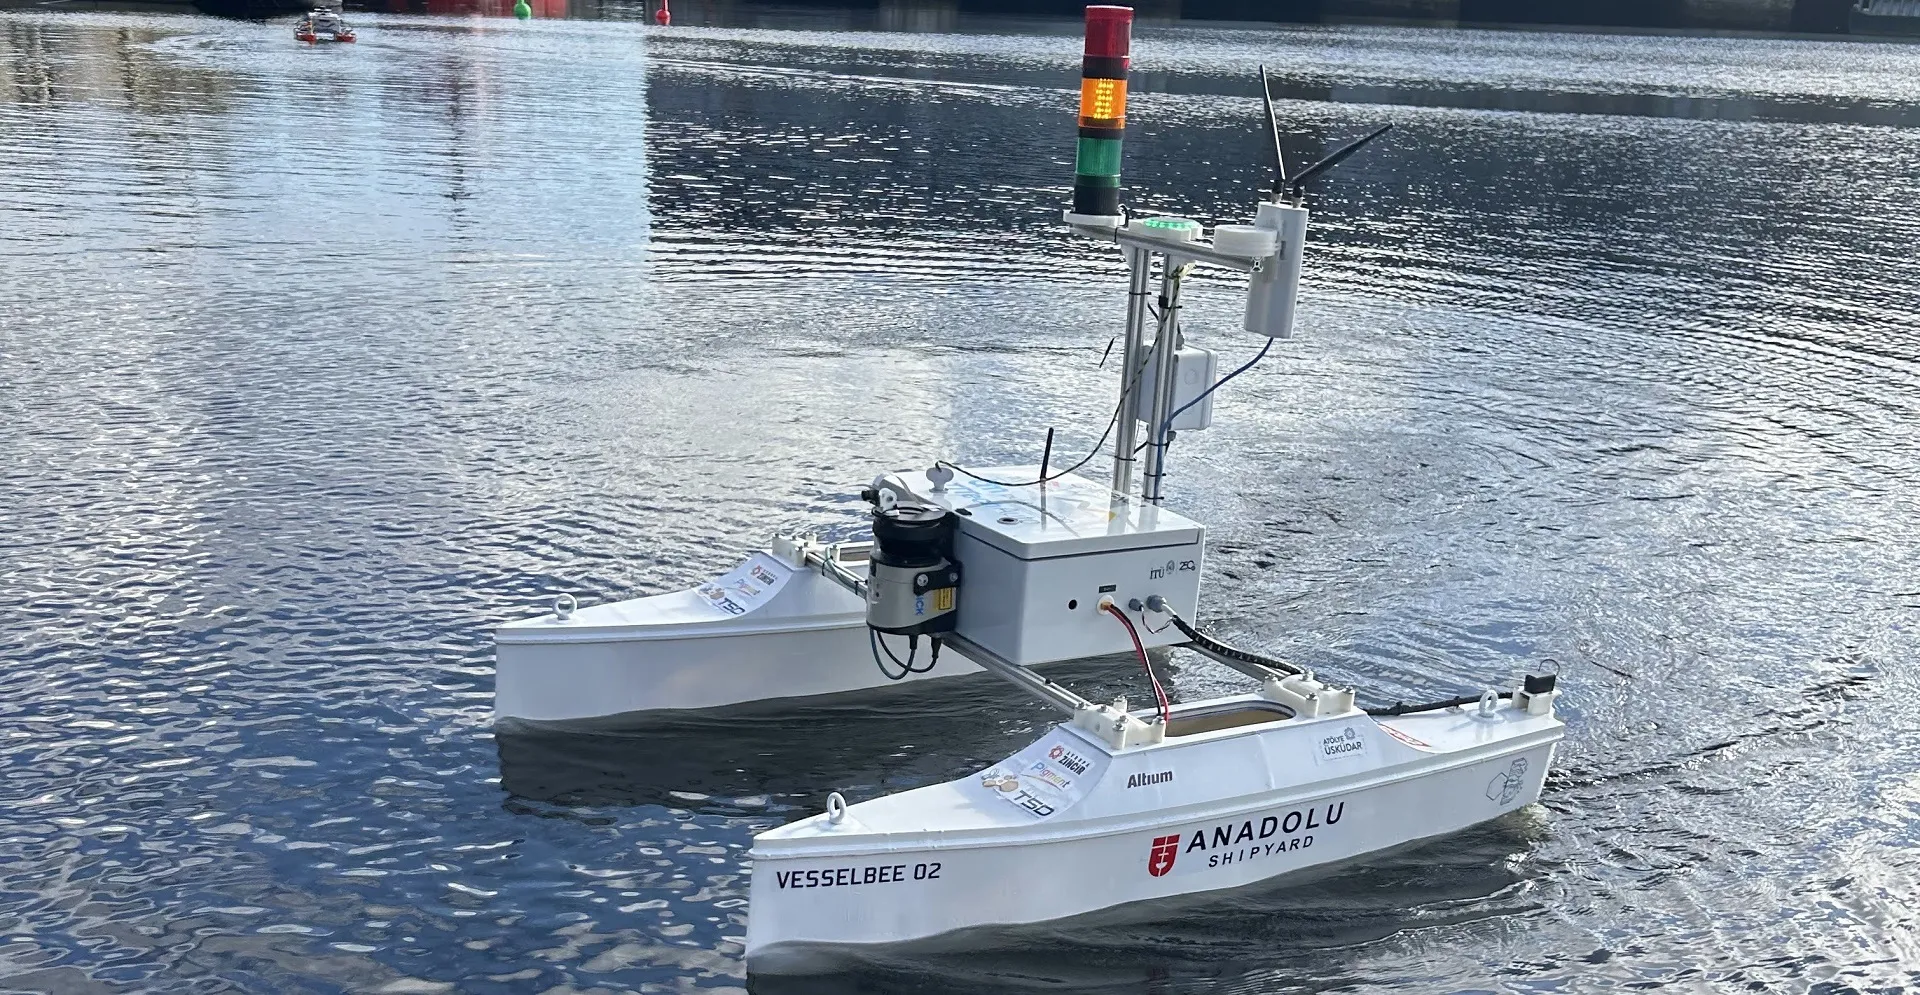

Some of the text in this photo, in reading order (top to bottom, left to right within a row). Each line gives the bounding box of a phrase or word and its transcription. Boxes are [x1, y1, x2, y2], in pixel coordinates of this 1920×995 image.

[718, 597, 746, 615] TSD
[1324, 741, 1363, 755] ÜSKÜDAR
[1031, 762, 1072, 788] Pigment
[1127, 770, 1173, 788] Altium
[1013, 789, 1055, 816] TSD
[1185, 801, 1345, 853] ANADOLU
[1208, 835, 1314, 867] SHIPYARD
[777, 862, 942, 889] VESSELBEE 02
